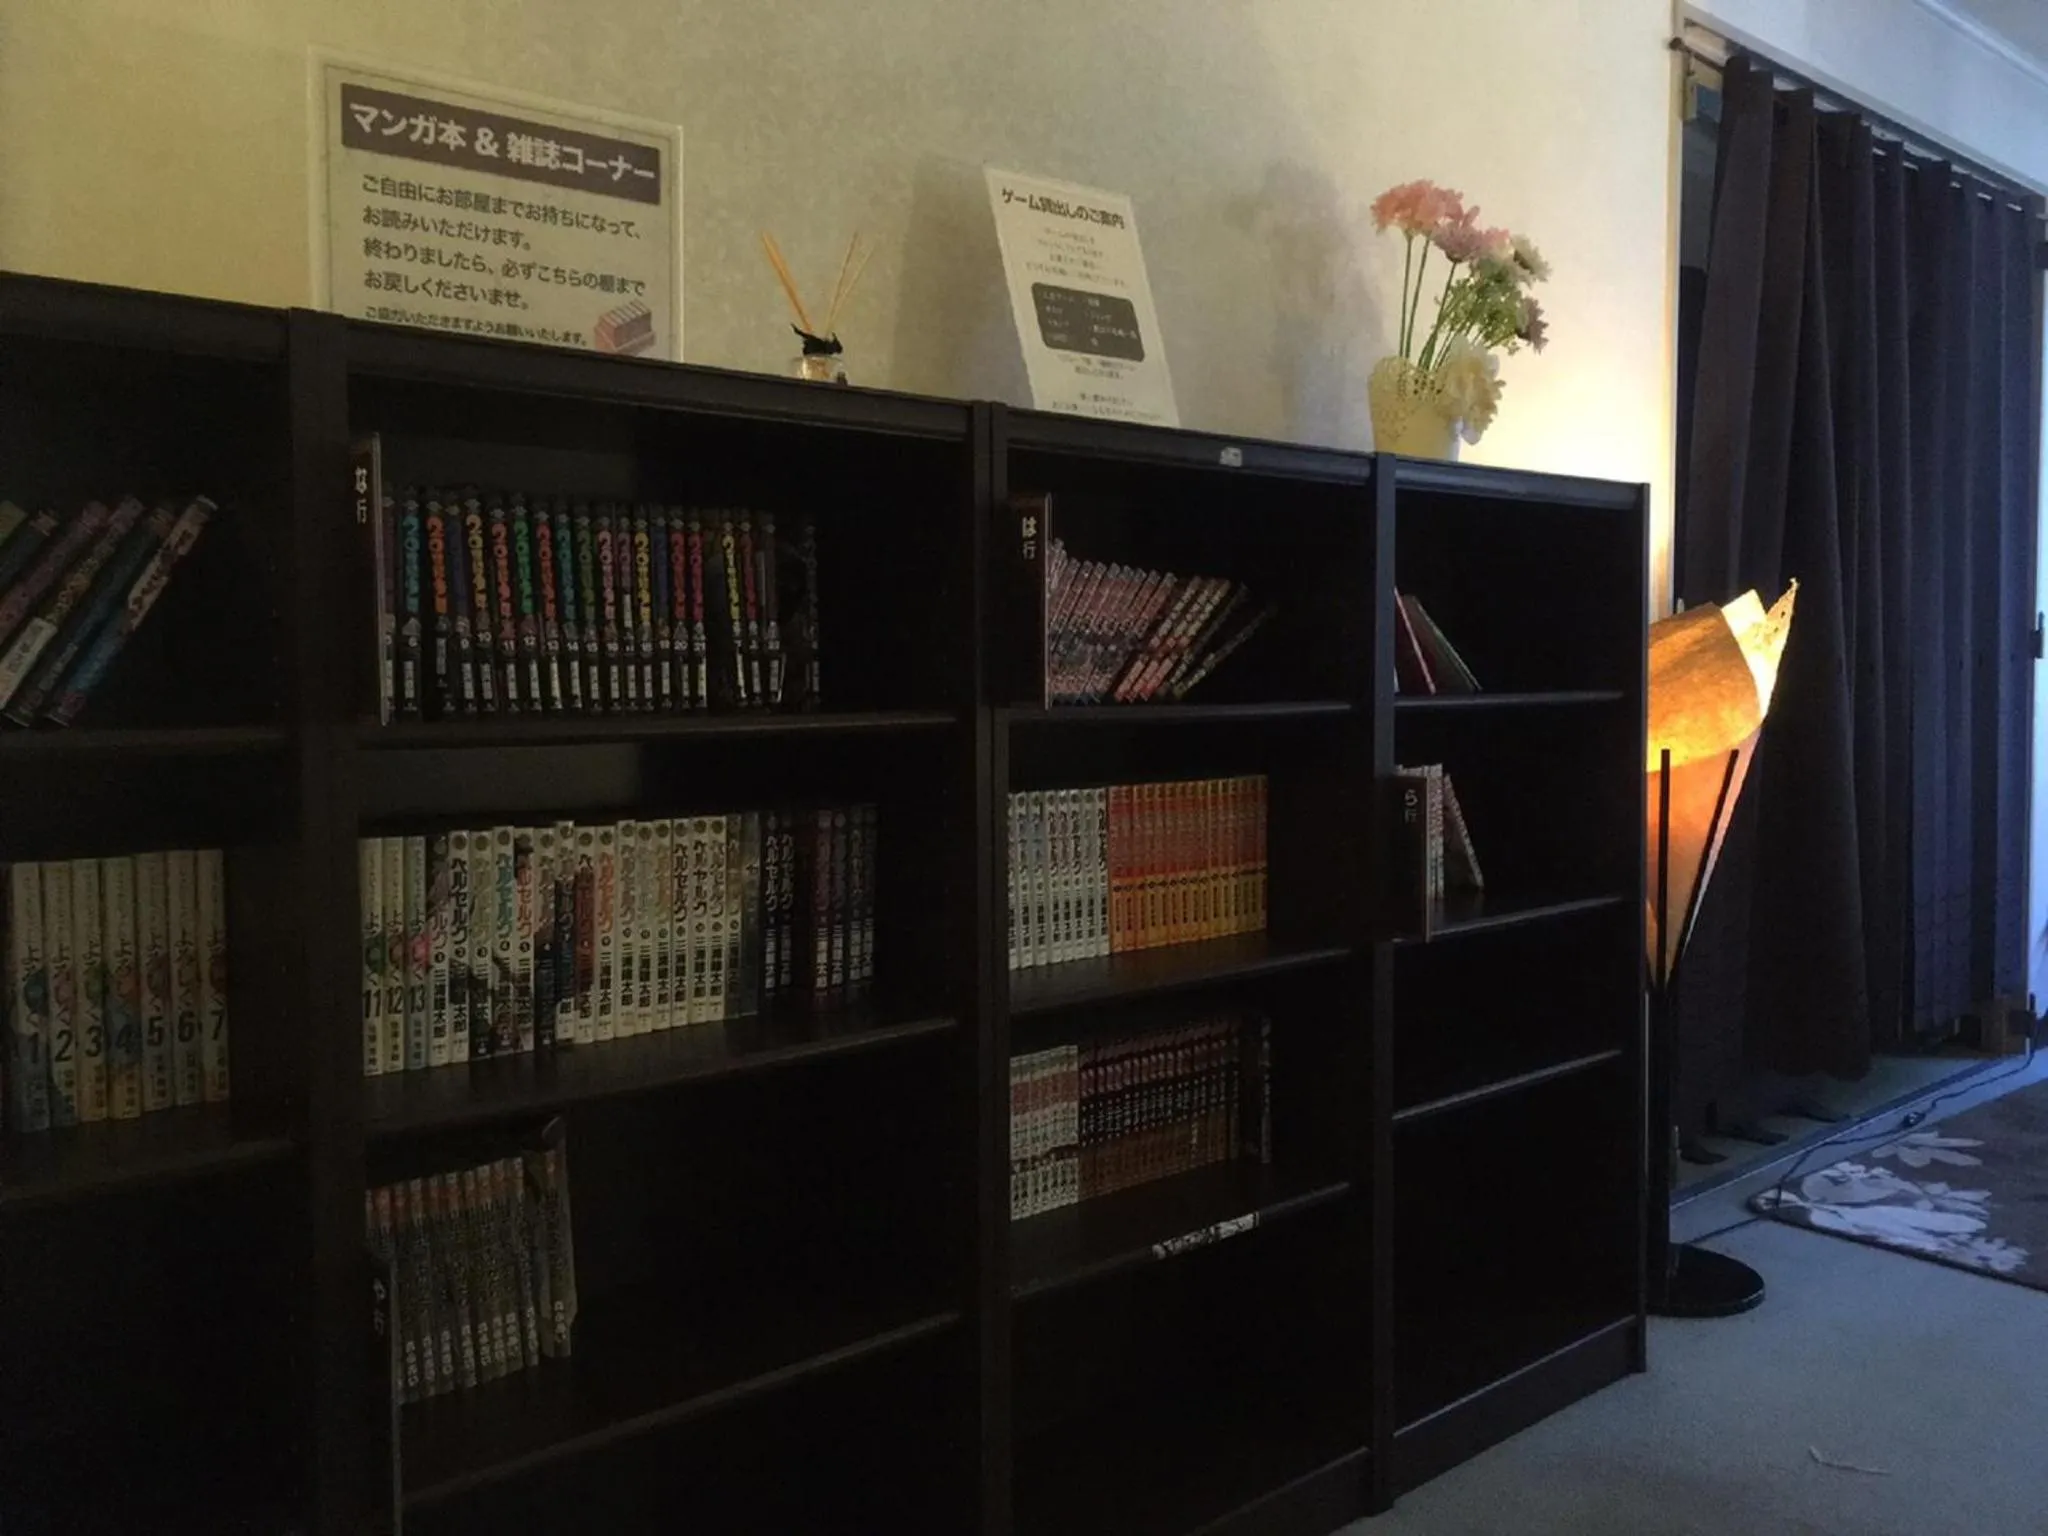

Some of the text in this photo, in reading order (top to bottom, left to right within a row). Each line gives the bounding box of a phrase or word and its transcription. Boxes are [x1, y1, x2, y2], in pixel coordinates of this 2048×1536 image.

[350, 102, 656, 182] マンガ本 & 雑誌コーナー
[362, 173, 641, 240] ご自由にお部屋までお持ちになって、
[362, 205, 531, 251] お読みいただけます。
[362, 237, 646, 297] 終わりましたら、必ずこちらの棚まで
[363, 269, 530, 311] お戻しくださいませ。
[674, 843, 688, 922] ベルセルク
[694, 840, 708, 917] ベルセルク
[765, 835, 780, 912] ベルセルク
[451, 858, 469, 945] ベルセルク
[364, 988, 381, 1018] 11
[387, 985, 403, 1014] 12
[410, 984, 426, 1014] 13
[85, 1026, 102, 1057] 3
[116, 1023, 141, 1054] 4
[147, 1015, 164, 1046] 5
[178, 1010, 196, 1042] 6
[210, 1010, 226, 1041] 7
[55, 1029, 73, 1062] 2
